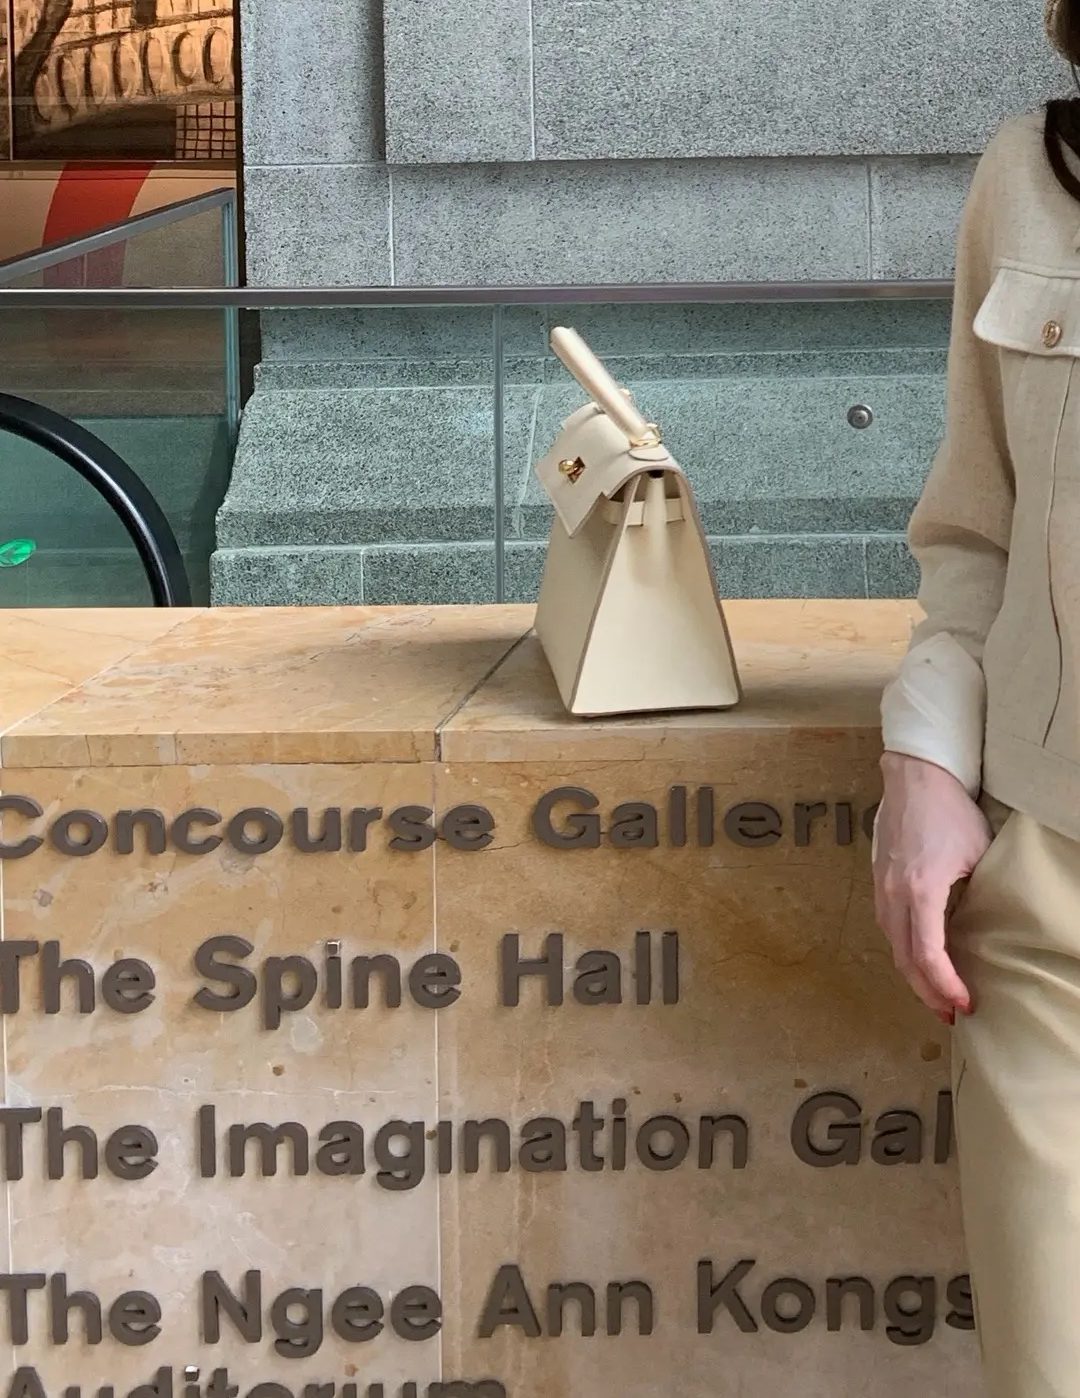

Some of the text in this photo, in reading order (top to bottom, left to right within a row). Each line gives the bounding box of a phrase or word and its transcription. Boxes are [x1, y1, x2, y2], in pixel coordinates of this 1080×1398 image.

[0, 785, 880, 860] Concourse Galleri
[0, 929, 680, 1031] The Spine Hall
[0, 1106, 159, 1181] The
[198, 1097, 749, 1191] Imagination
[0, 1271, 163, 1347] The
[201, 1269, 443, 1359] Ngee
[477, 1263, 655, 1339] Ann
